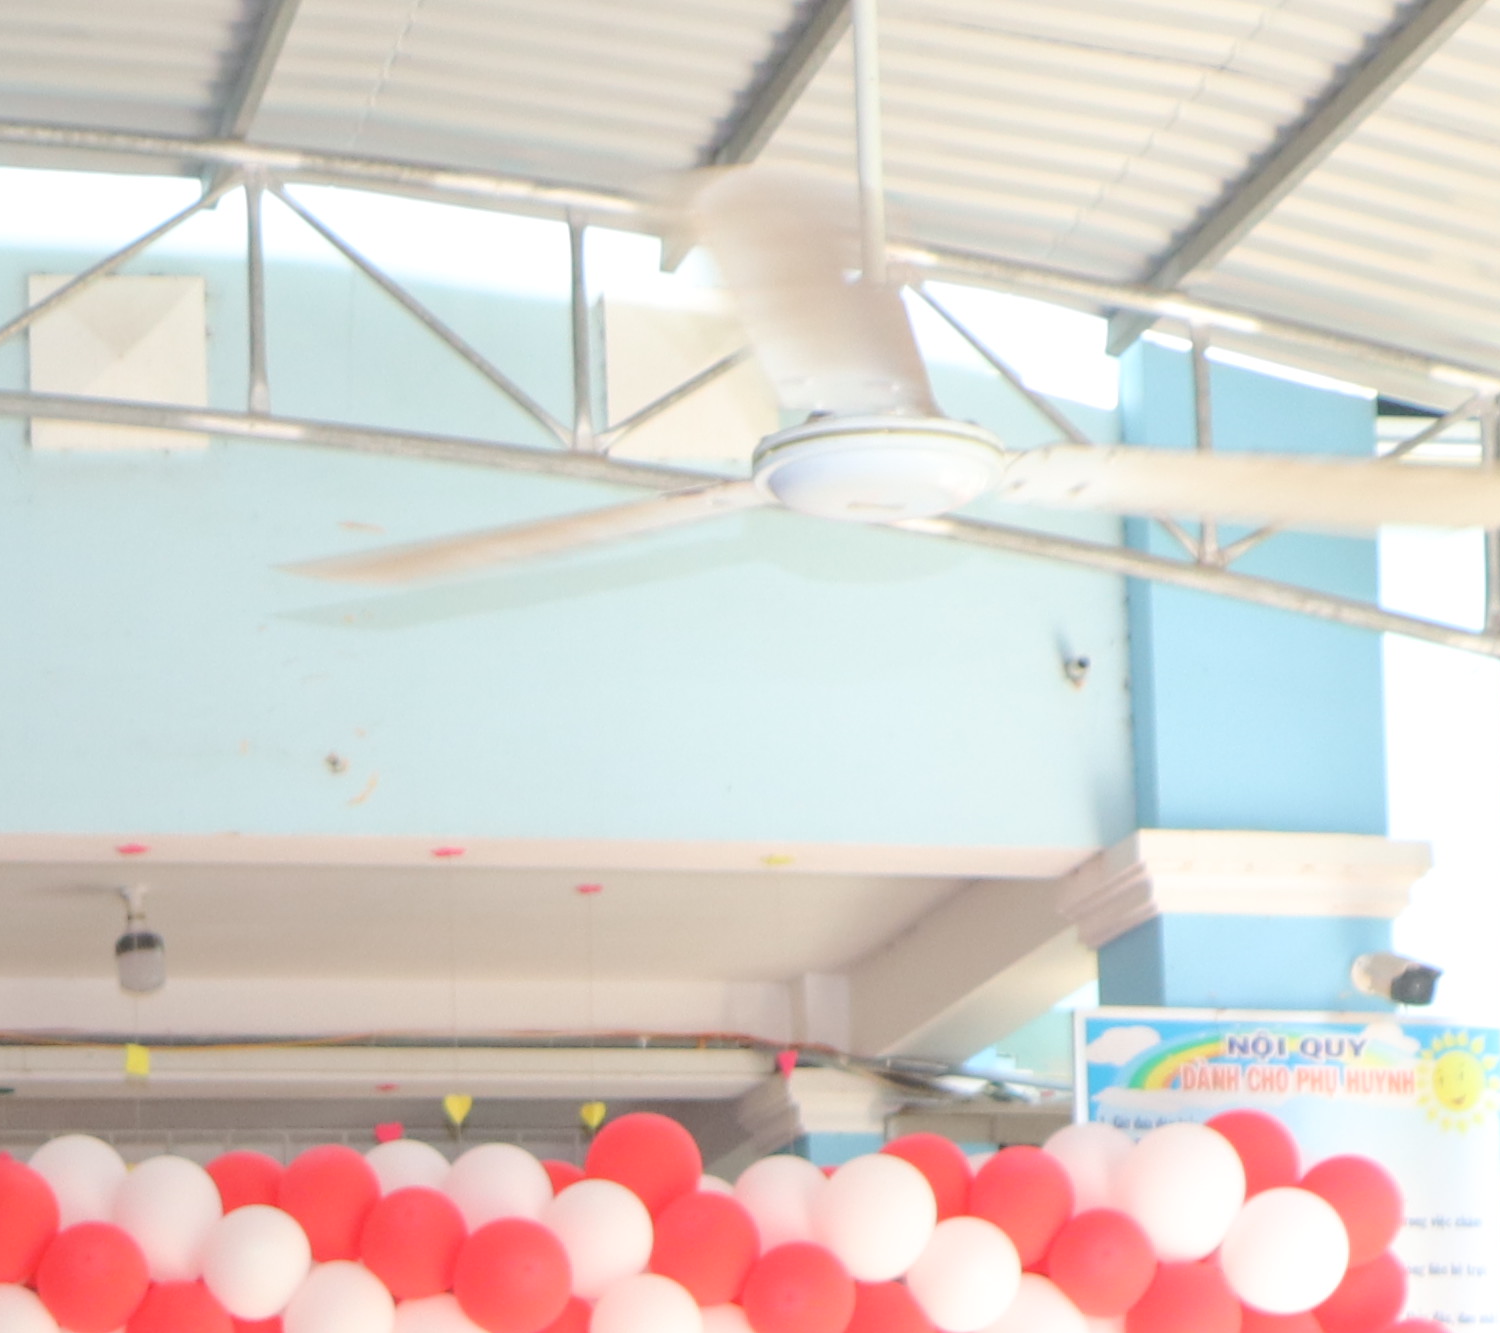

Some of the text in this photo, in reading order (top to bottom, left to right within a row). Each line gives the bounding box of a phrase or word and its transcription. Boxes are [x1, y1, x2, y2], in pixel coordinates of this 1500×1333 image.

[1227, 1031, 1368, 1064] NỘI QUY
[1181, 1058, 1416, 1097] DÀNH CHO PHỤ HUYNH
